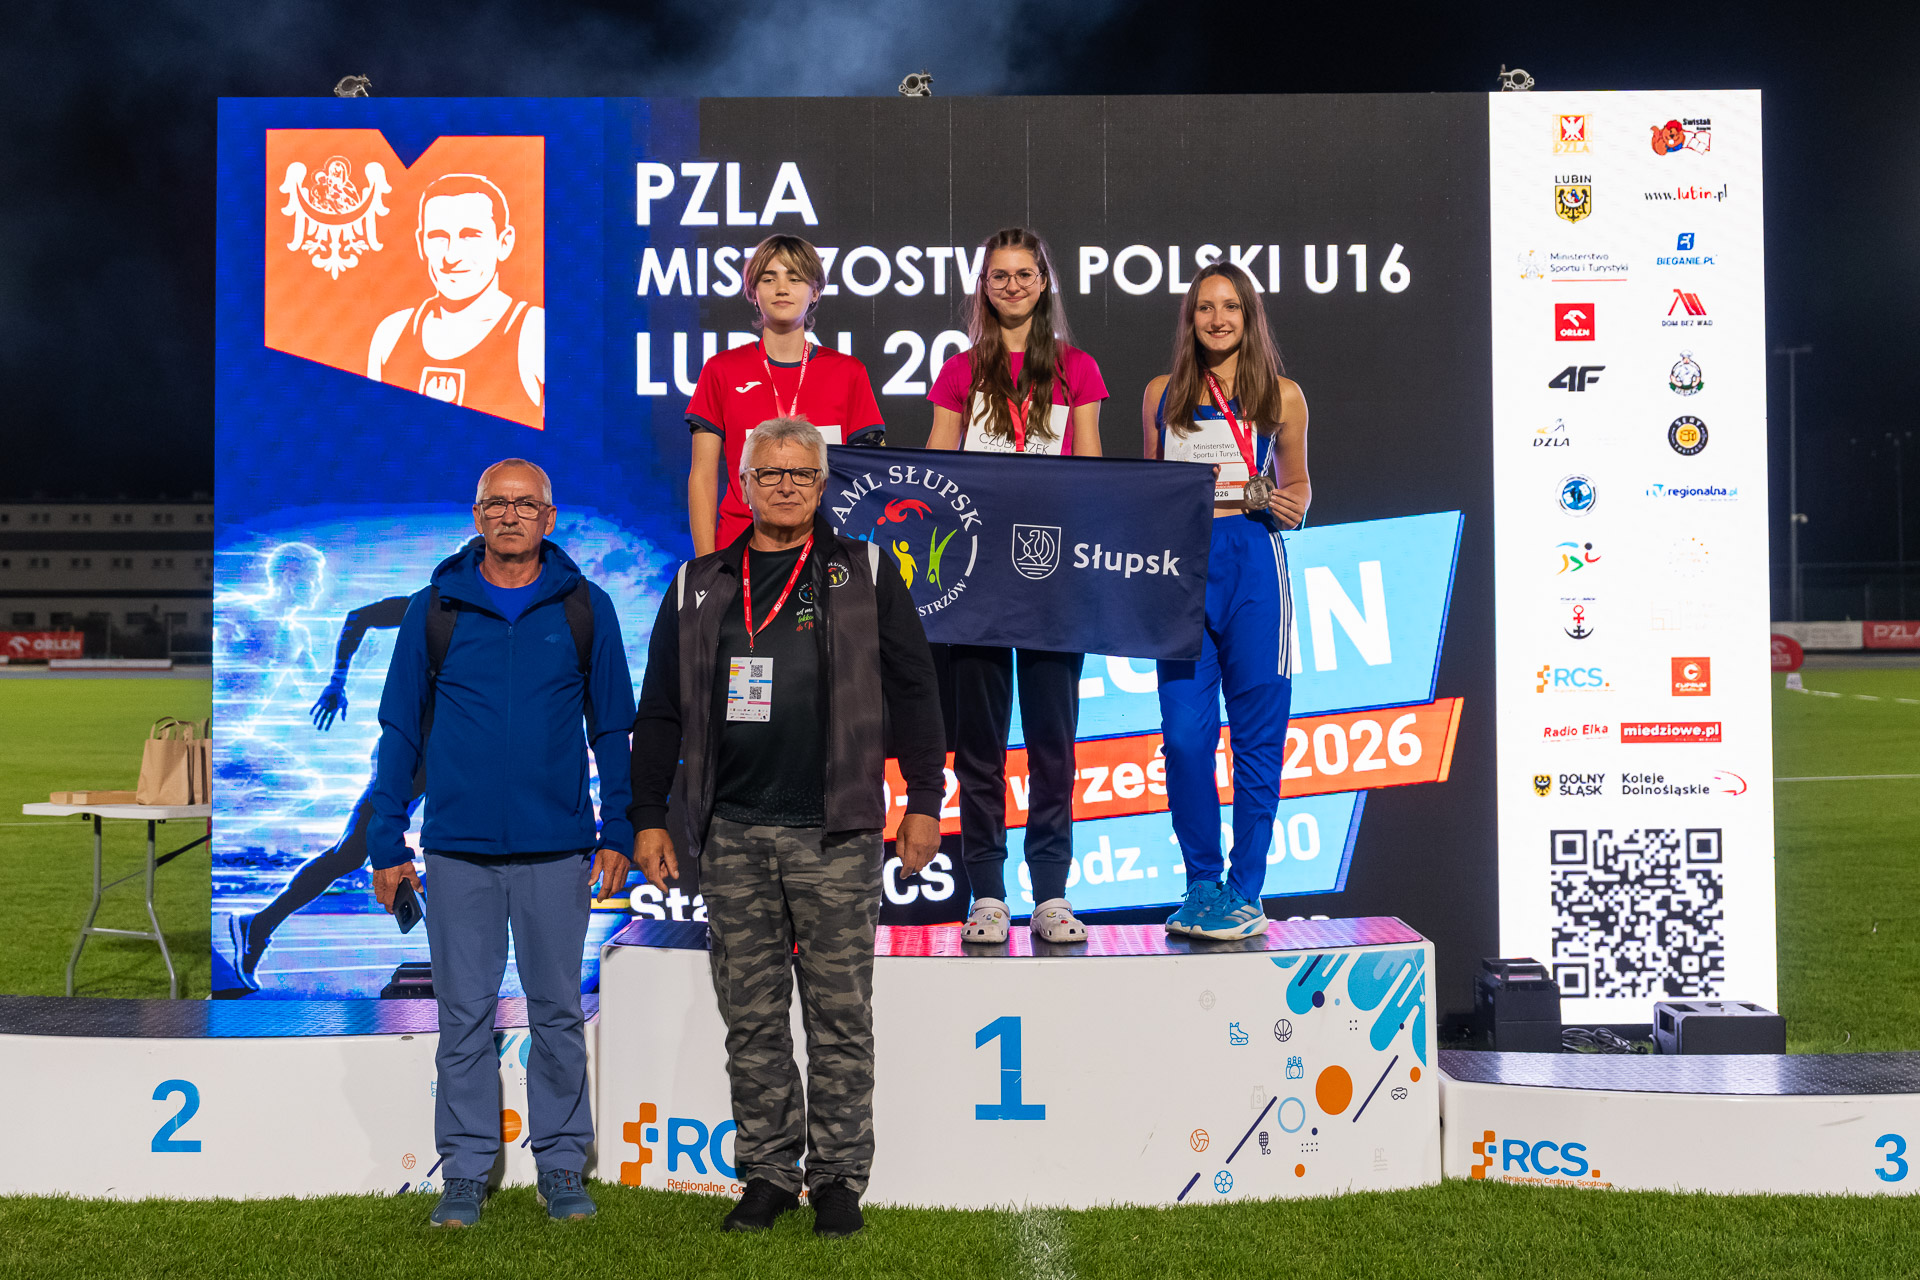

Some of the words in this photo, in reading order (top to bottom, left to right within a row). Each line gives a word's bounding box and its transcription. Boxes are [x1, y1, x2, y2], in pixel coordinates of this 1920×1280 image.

[1554, 142, 1591, 154] PZLA
[1555, 175, 1592, 183] LUBIN
[636, 162, 819, 226] PZLA
[1644, 184, 1727, 202] www.lubin.pl
[1550, 252, 1609, 261] Ministerstwo
[1656, 256, 1715, 266] BIEGANIE.PL
[1304, 243, 1412, 294] U16
[1550, 263, 1580, 273] Sportu
[1589, 262, 1629, 273] Turystyki
[1560, 328, 1590, 337] ORLEN
[1548, 365, 1606, 392] 4F
[979, 432, 1049, 455] CZUBZEK
[1533, 438, 1570, 447] DZLA
[1193, 451, 1215, 459] Sportu
[888, 465, 983, 532] SŁUPSK
[1073, 543, 1181, 579] Słupsk
[915, 579, 968, 617] STRZÓW
[34, 637, 81, 651] ORLEN
[1543, 726, 1578, 738] Radio
[1582, 724, 1609, 735] Elka
[1623, 724, 1719, 737] miedziowe.pl
[1281, 713, 1423, 780] 2026
[1559, 774, 1606, 785] DOLNY
[1622, 773, 1665, 785] Koleje
[1559, 784, 1603, 797] ŚLĄSK
[1622, 784, 1710, 797] Dolnośląskie
[880, 852, 955, 906] CS
[975, 1016, 1046, 1120] 1
[151, 1079, 202, 1153] 2
[1874, 1133, 1909, 1183] 3
[667, 1179, 726, 1193] Regionalne
[1502, 1174, 1542, 1185] Regionalne
[1544, 1177, 1574, 1187] Centrum
